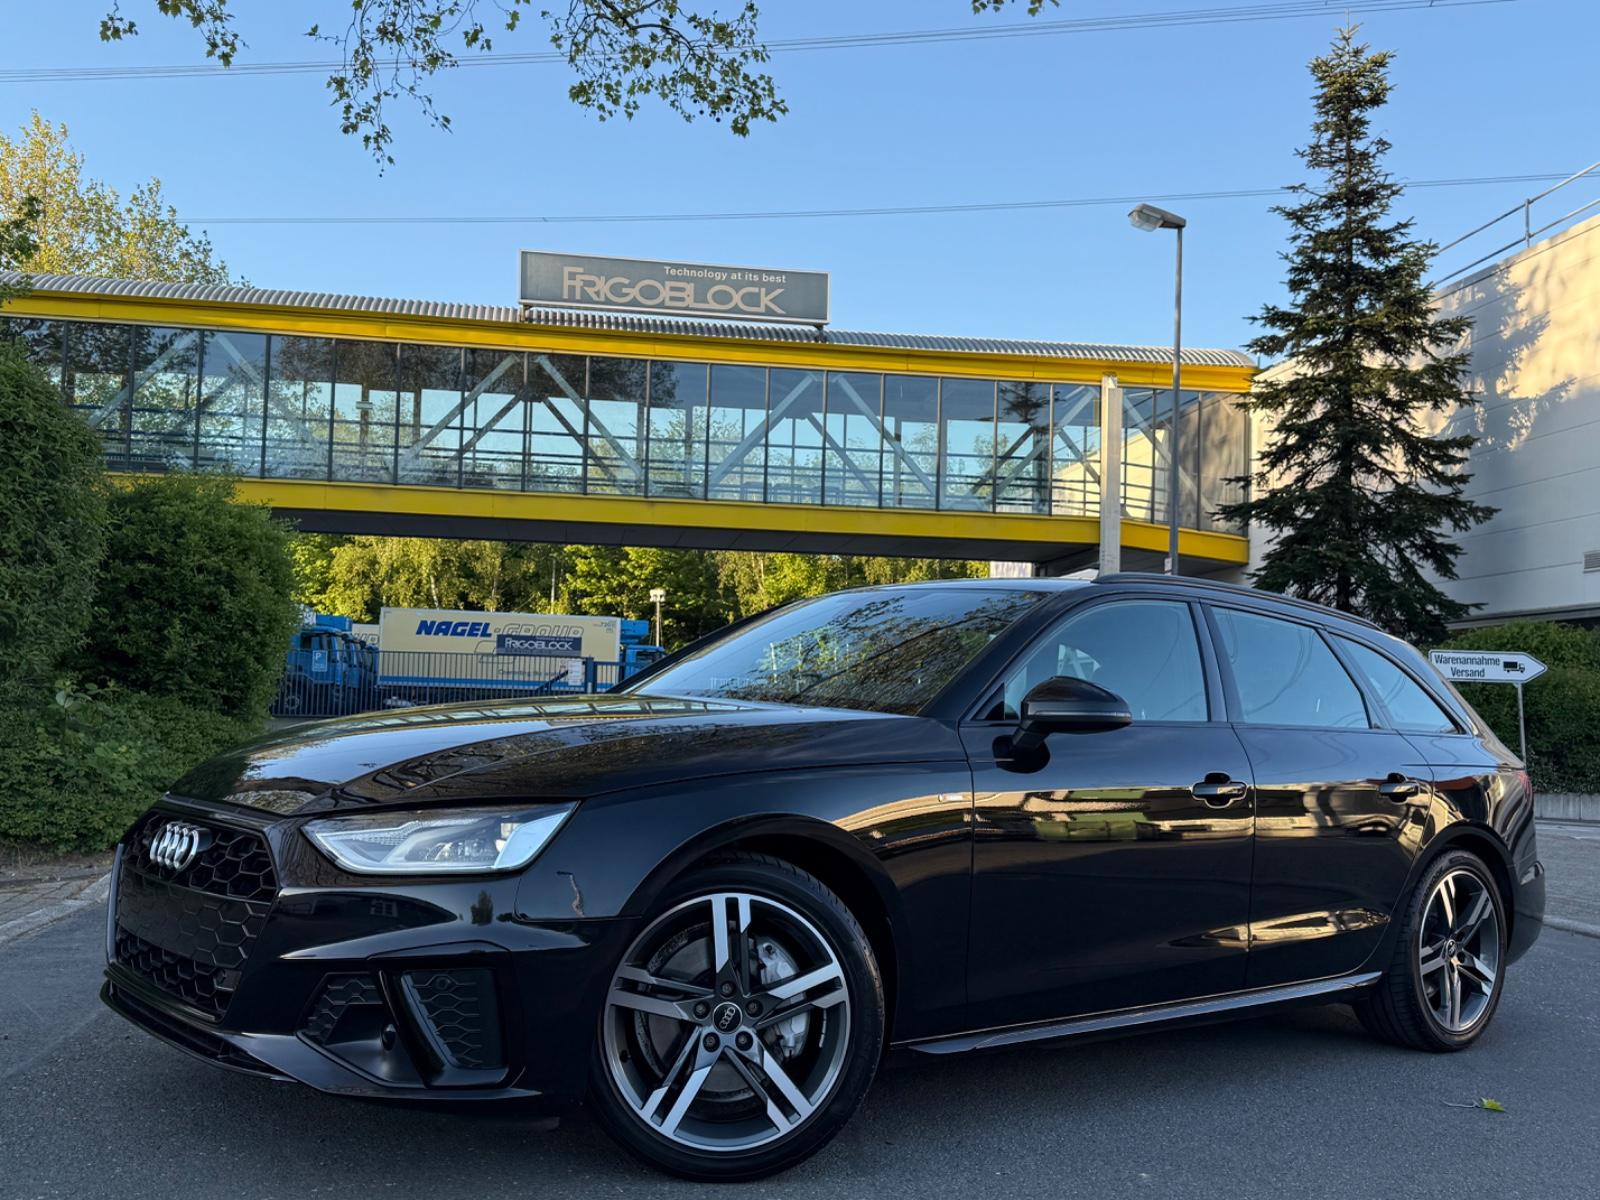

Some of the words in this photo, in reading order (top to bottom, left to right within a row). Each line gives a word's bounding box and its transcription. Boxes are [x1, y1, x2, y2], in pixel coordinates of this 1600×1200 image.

[663, 266, 728, 281] Technology
[731, 271, 742, 280] at
[745, 271, 759, 282] its
[762, 273, 786, 284] best
[562, 266, 786, 314] FRIGOBLOCK
[416, 620, 492, 638] NAGEL
[504, 637, 573, 650] FRIGOBLOCK
[1434, 654, 1500, 666] Warenannahme
[1450, 667, 1485, 678] Versand
